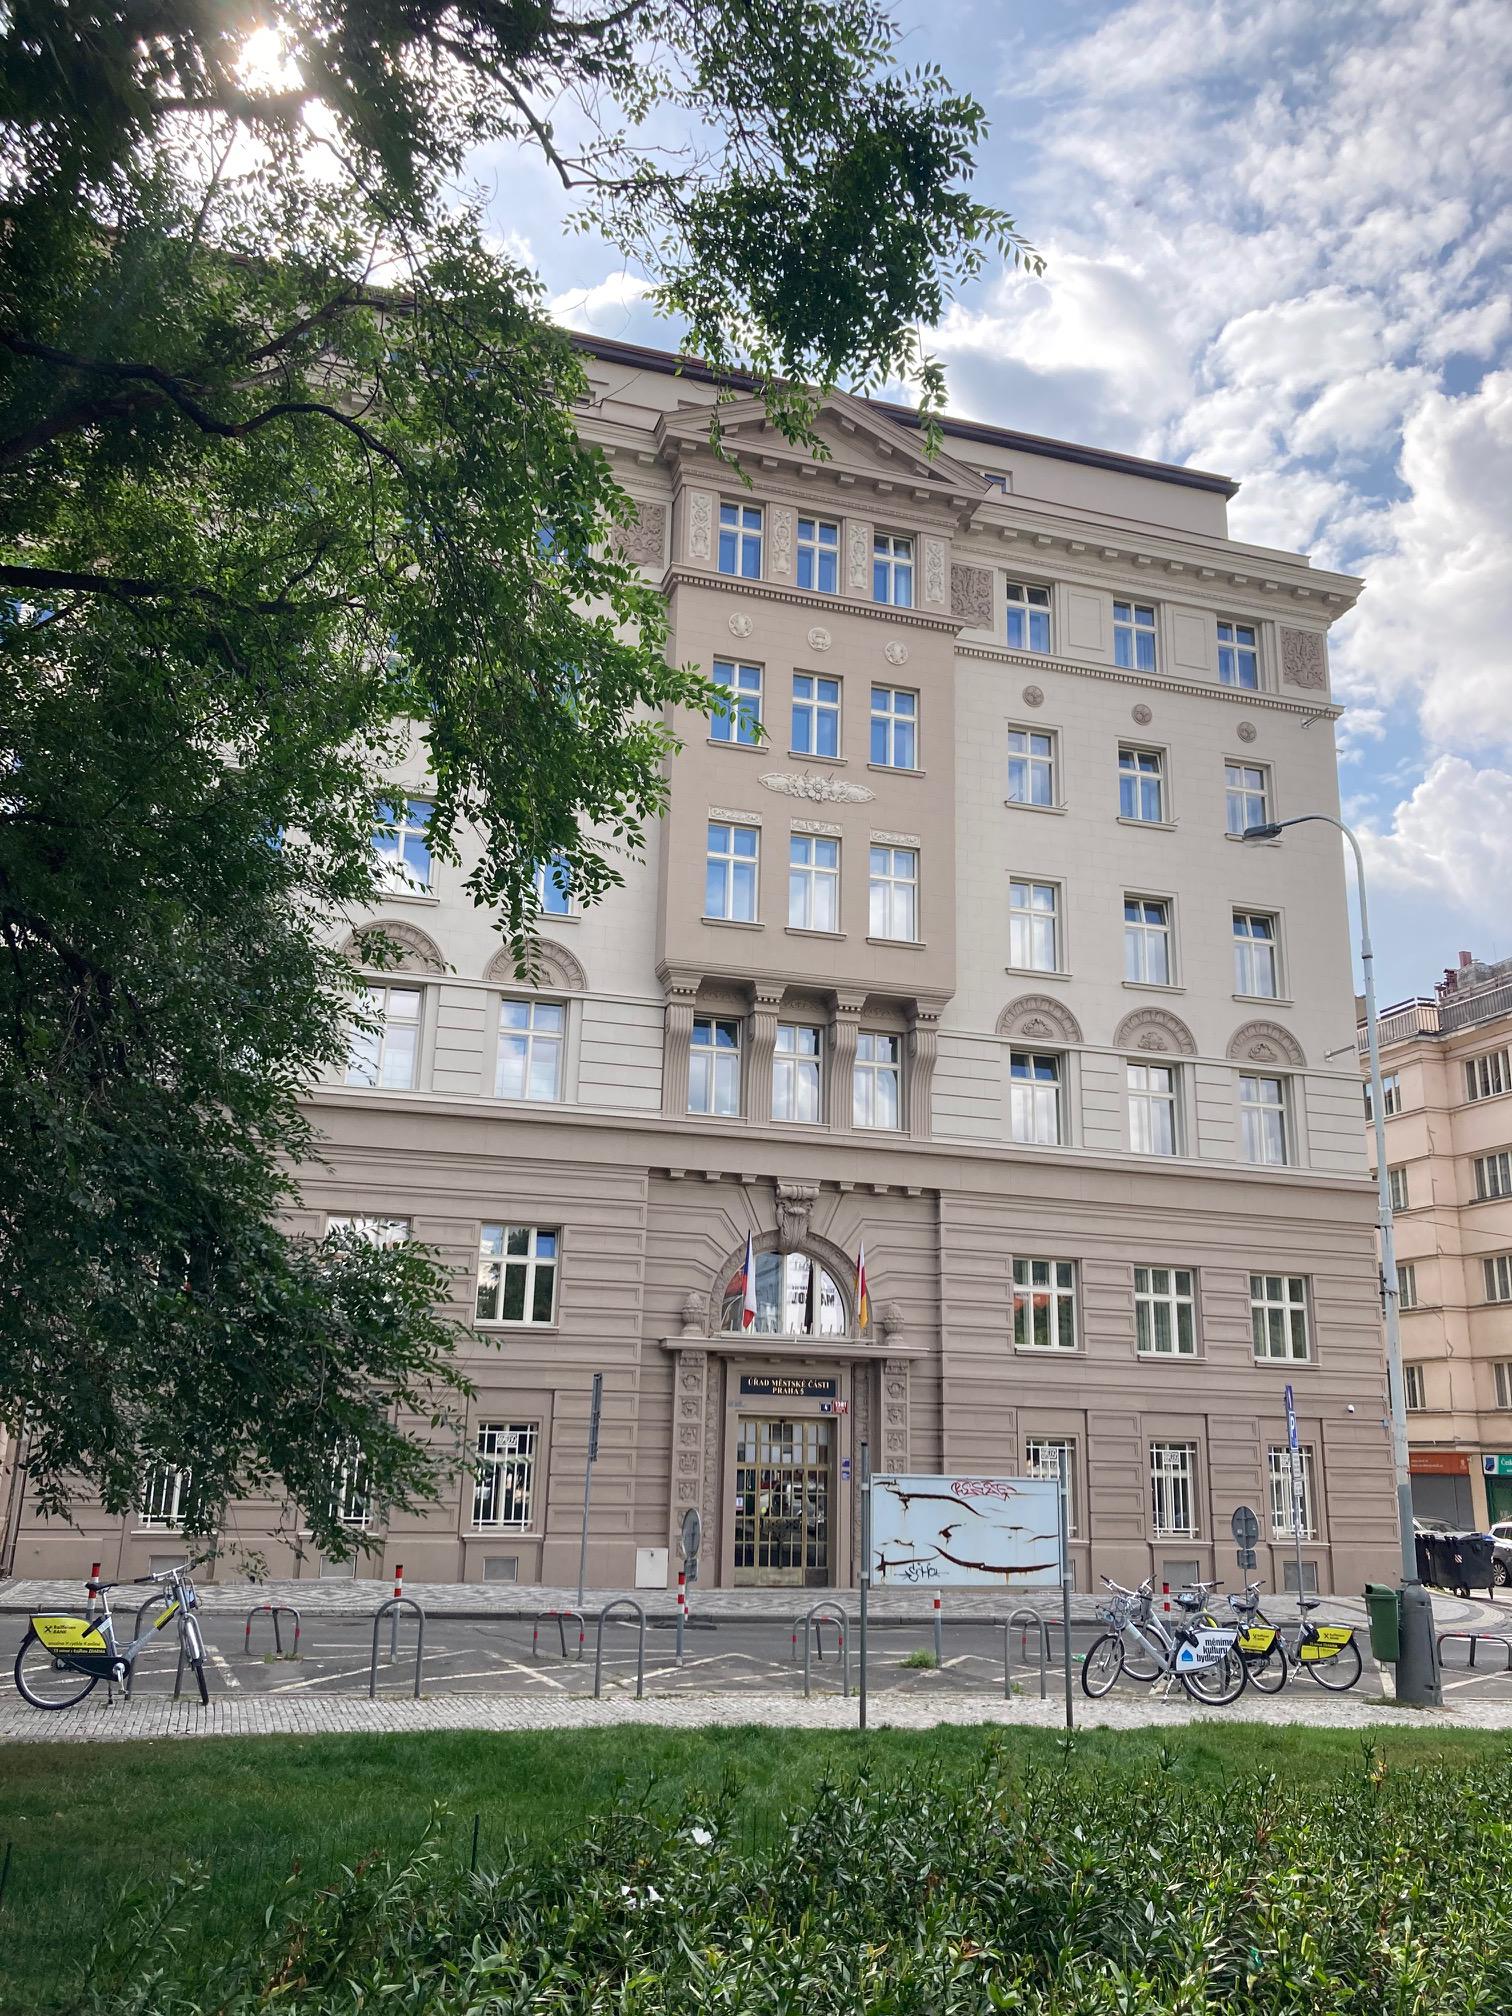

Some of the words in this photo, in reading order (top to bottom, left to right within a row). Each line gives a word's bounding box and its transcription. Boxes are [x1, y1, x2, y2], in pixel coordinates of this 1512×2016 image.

[748, 1377, 769, 1386] ÚŘAD
[771, 1378, 805, 1388] MĚSTSKÉ
[808, 1379, 829, 1389] ČÁSTI
[772, 1387, 799, 1395] PRAHA
[800, 1388, 805, 1396] 5
